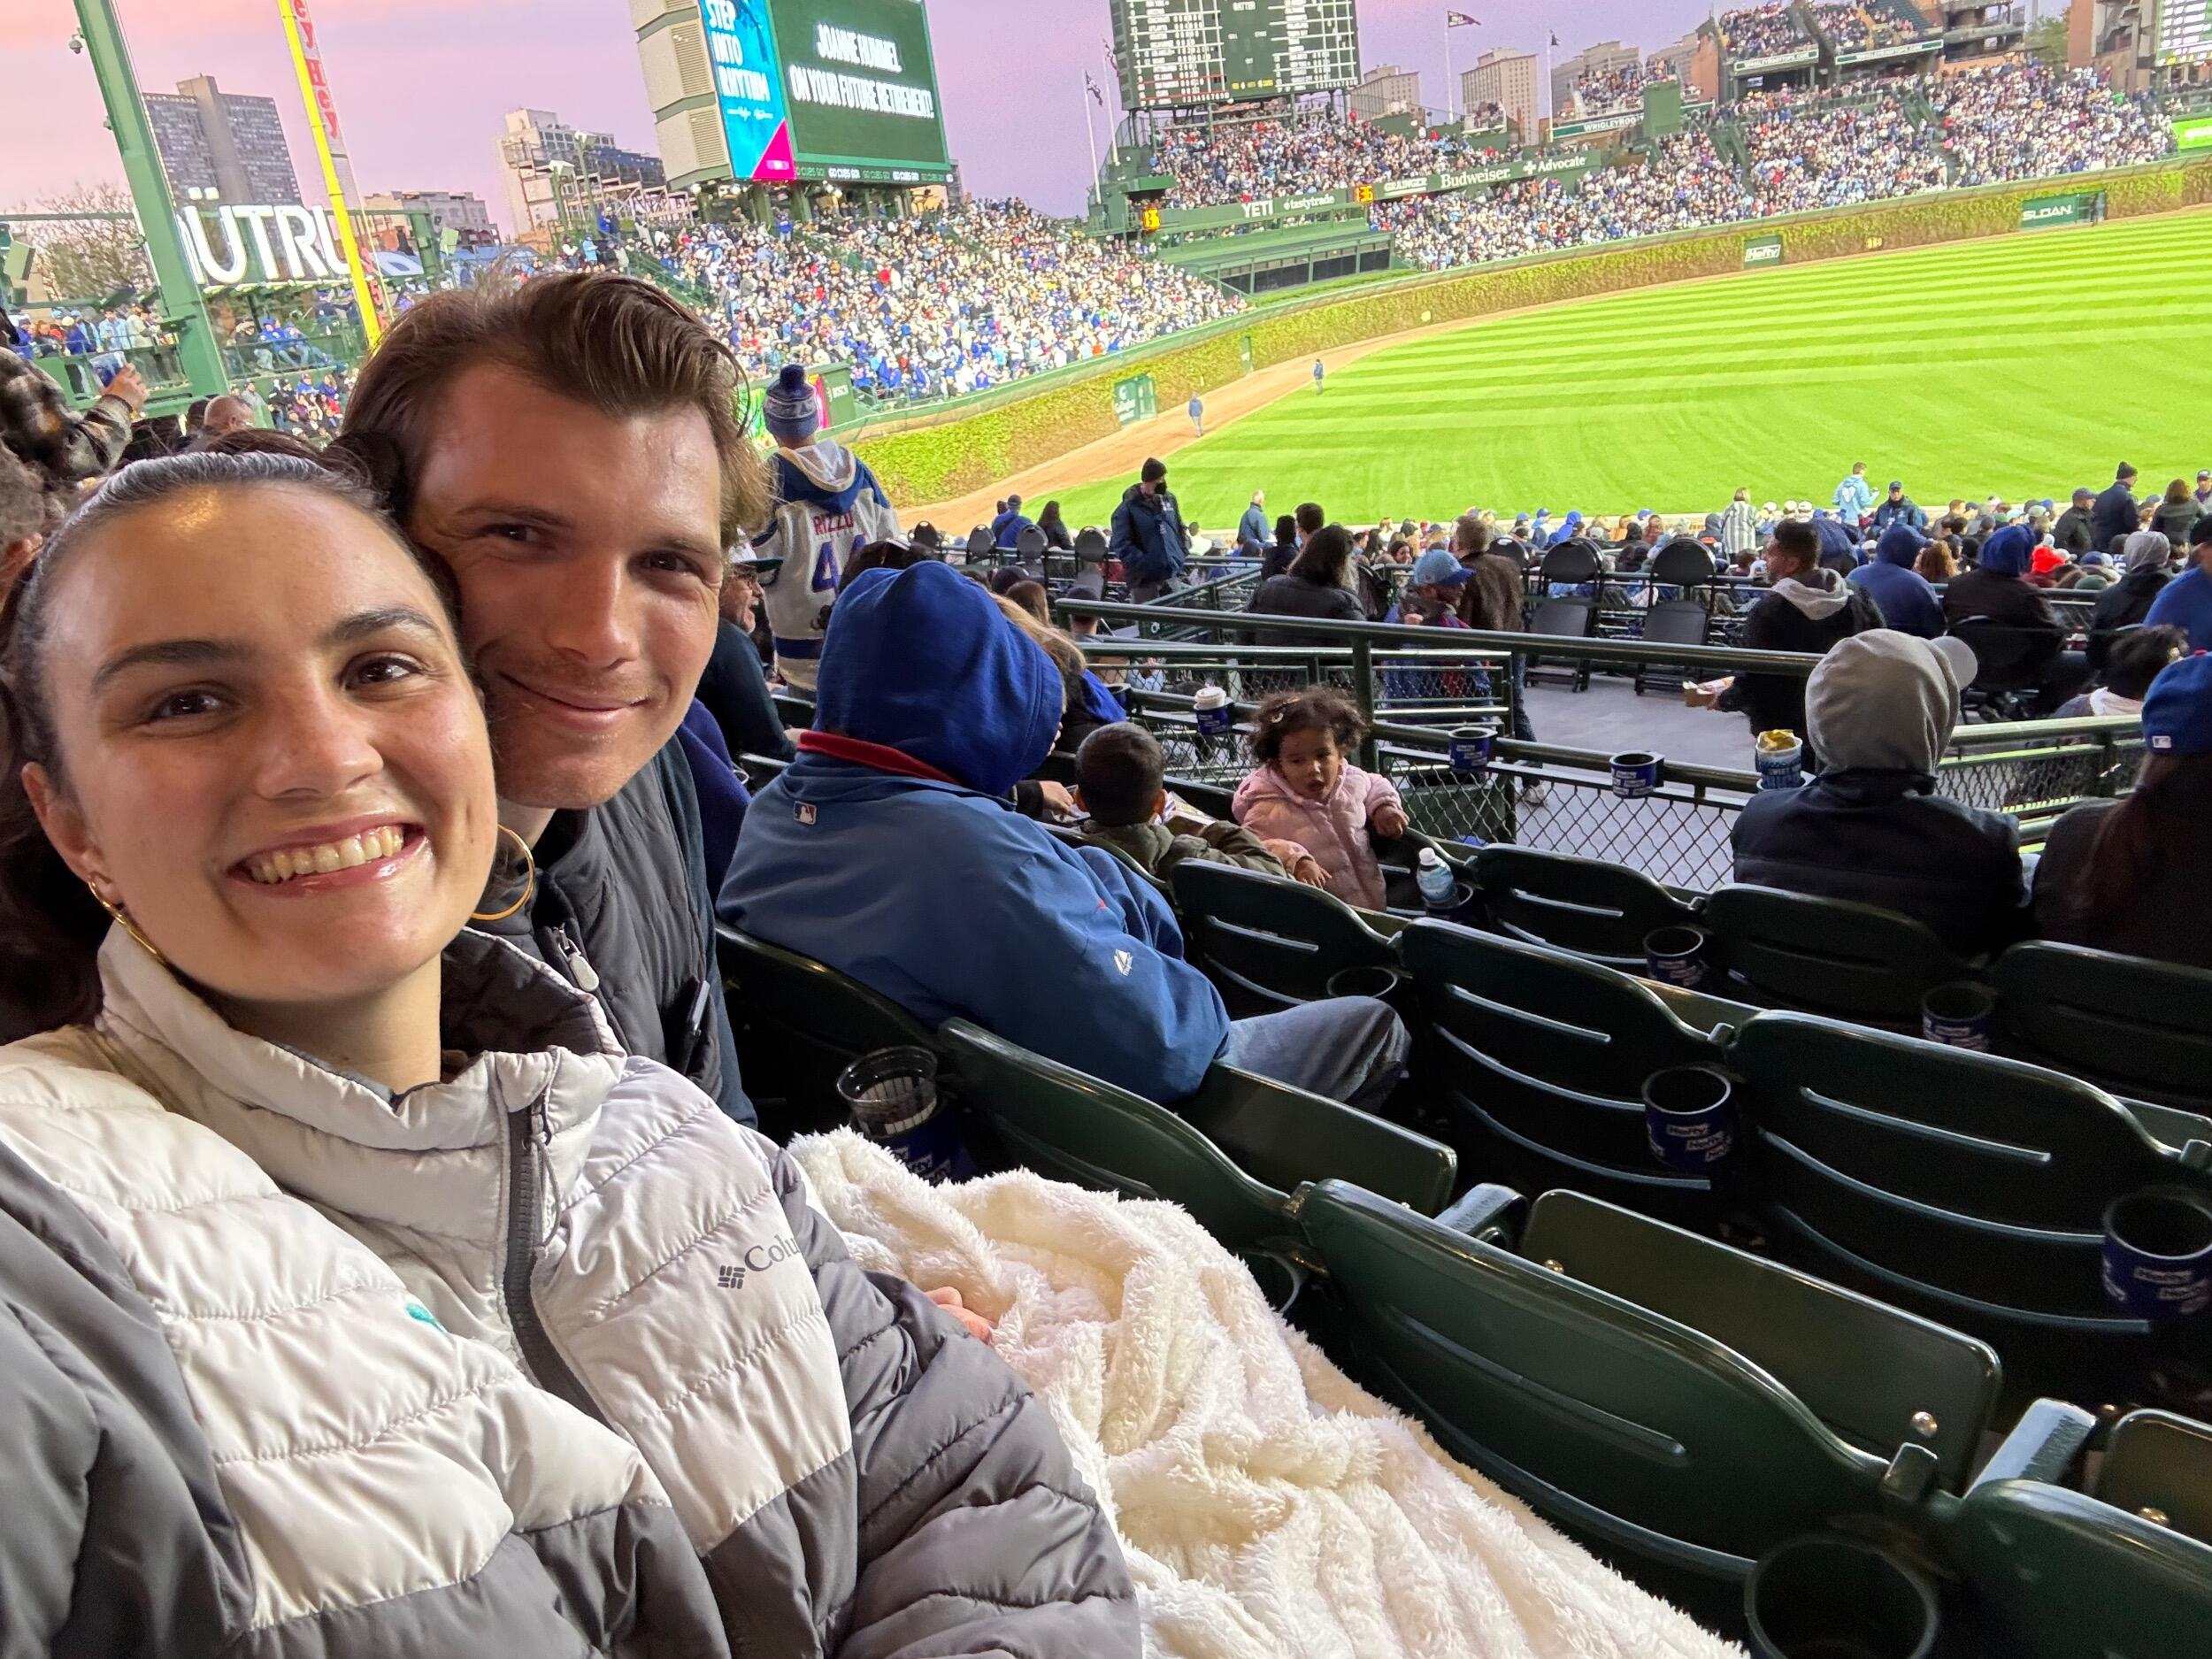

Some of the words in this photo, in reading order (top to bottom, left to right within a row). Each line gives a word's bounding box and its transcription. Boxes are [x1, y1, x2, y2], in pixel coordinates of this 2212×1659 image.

[705, 0, 735, 31] STEP
[711, 31, 743, 66] INTO
[816, 23, 861, 65] JOANNE
[857, 34, 902, 73] HUMMEL
[718, 65, 772, 103] RHYTHM
[789, 64, 811, 102] ON
[807, 68, 842, 107] YOUR
[838, 74, 879, 112] FUTURE
[876, 81, 935, 119] RETIREMENT!
[305, 58, 338, 139] Hey
[1538, 156, 1587, 173] Advocate
[1383, 178, 1427, 192] GRAINGER
[1241, 200, 1273, 219] YETI
[1289, 194, 1335, 211] tastytrade
[2022, 205, 2072, 222] SLOAN
[1747, 247, 1779, 261] Hefty
